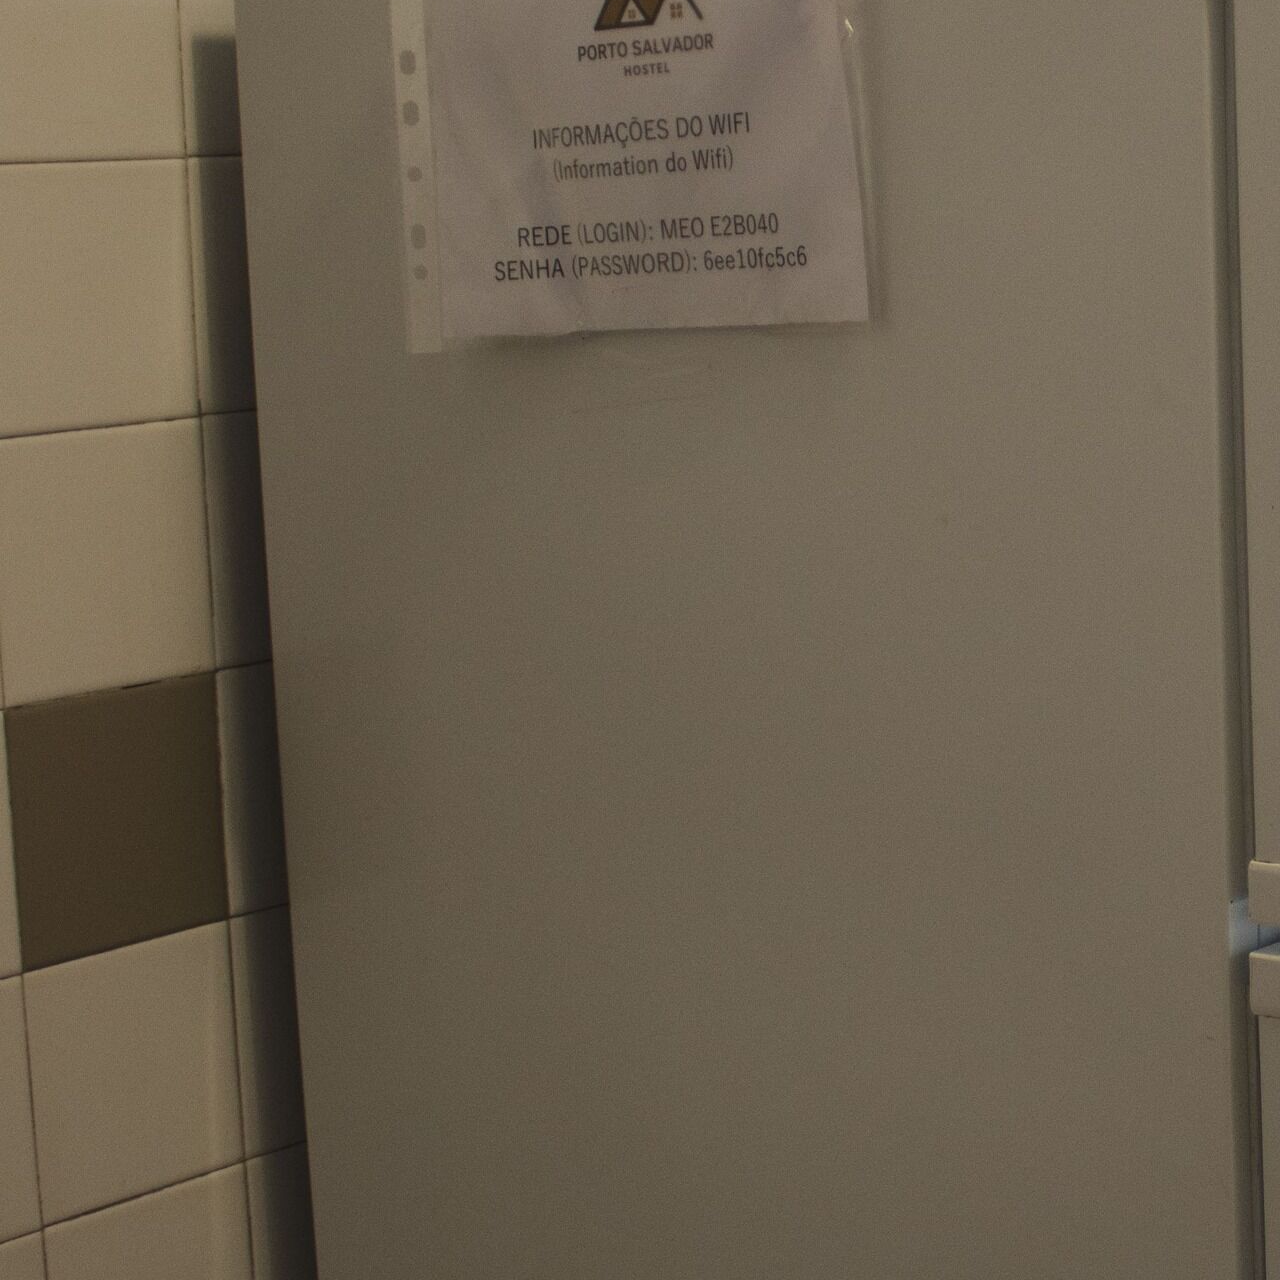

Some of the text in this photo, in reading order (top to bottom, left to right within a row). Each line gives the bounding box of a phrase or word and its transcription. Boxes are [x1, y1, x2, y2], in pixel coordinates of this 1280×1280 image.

[577, 33, 715, 62] PORTO SALVADOR
[623, 62, 670, 77] HOSTEL
[532, 112, 751, 149] INFORMAÇÕES DO WIFI
[553, 144, 734, 183] (Information do Wifi)
[517, 212, 779, 247] REDE (LOGIN): MEO E2B040
[494, 245, 808, 282] SENHA (PASSWORD): 6ee10fc5c6
